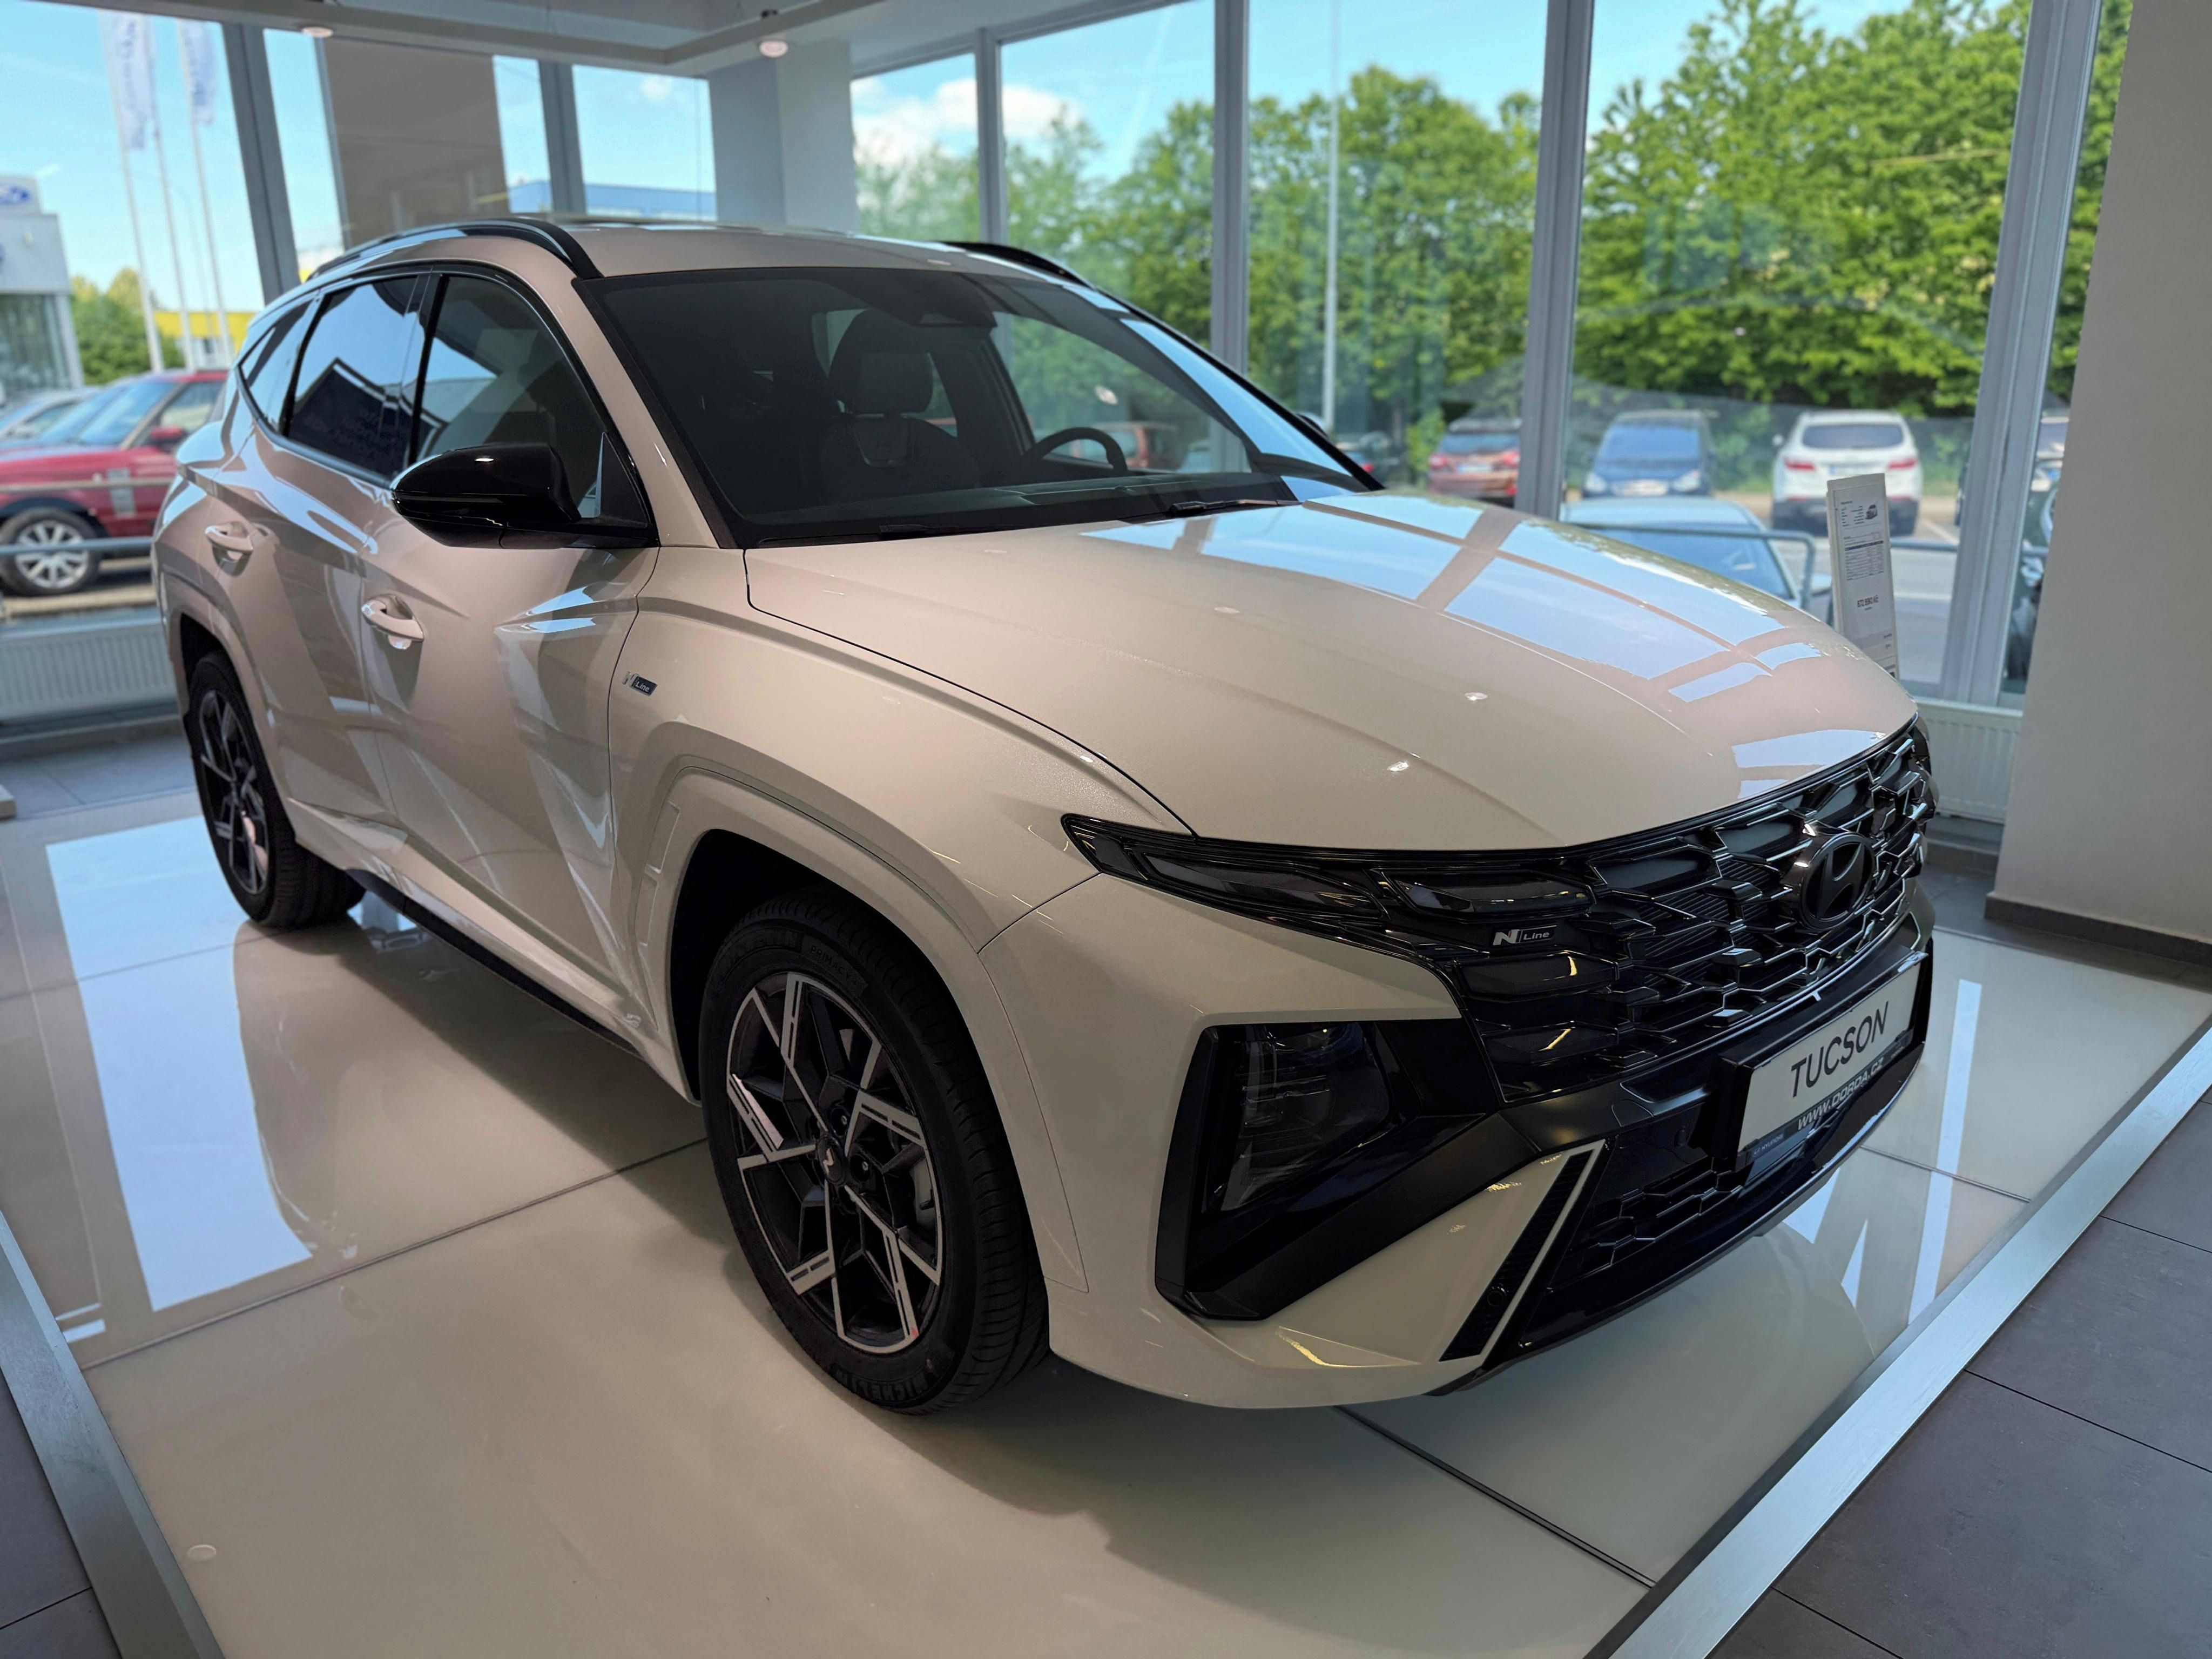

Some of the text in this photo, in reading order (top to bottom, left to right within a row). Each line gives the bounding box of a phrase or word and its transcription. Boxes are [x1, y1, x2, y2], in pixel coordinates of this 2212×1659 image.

[635, 681, 650, 692] Line
[1493, 929, 1550, 946] N Line
[810, 945, 852, 981] PRIMACY
[1791, 1001, 1889, 1098] TUCSON
[1797, 1056, 1885, 1130] WWW.DORDA.CZ
